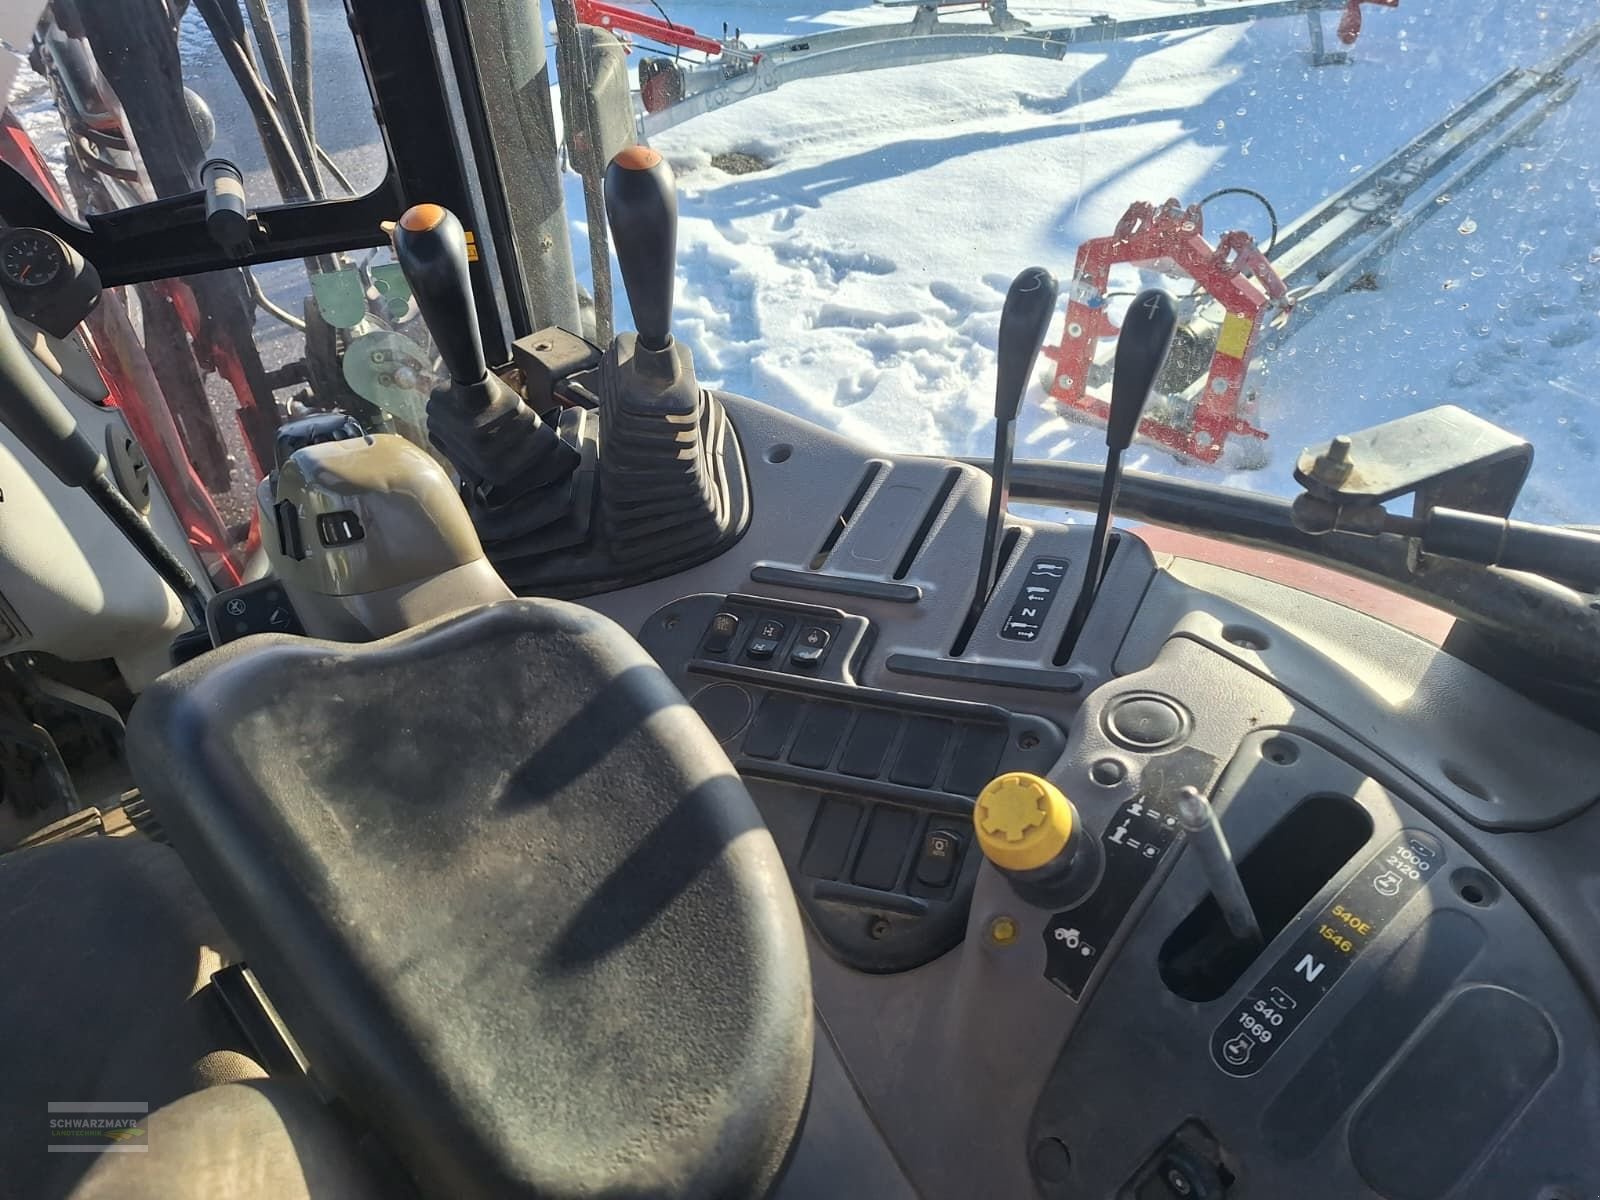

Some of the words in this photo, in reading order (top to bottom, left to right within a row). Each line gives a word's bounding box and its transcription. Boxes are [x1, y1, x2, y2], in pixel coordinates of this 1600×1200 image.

[1143, 294, 1160, 320] 4
[1386, 855, 1420, 880] 2120
[1396, 846, 1430, 871] 1000
[1331, 904, 1371, 935] 540E
[1318, 924, 1353, 952] 1546
[1294, 953, 1326, 983] N
[1253, 1000, 1283, 1026] 540
[1238, 1012, 1273, 1043] 1969
